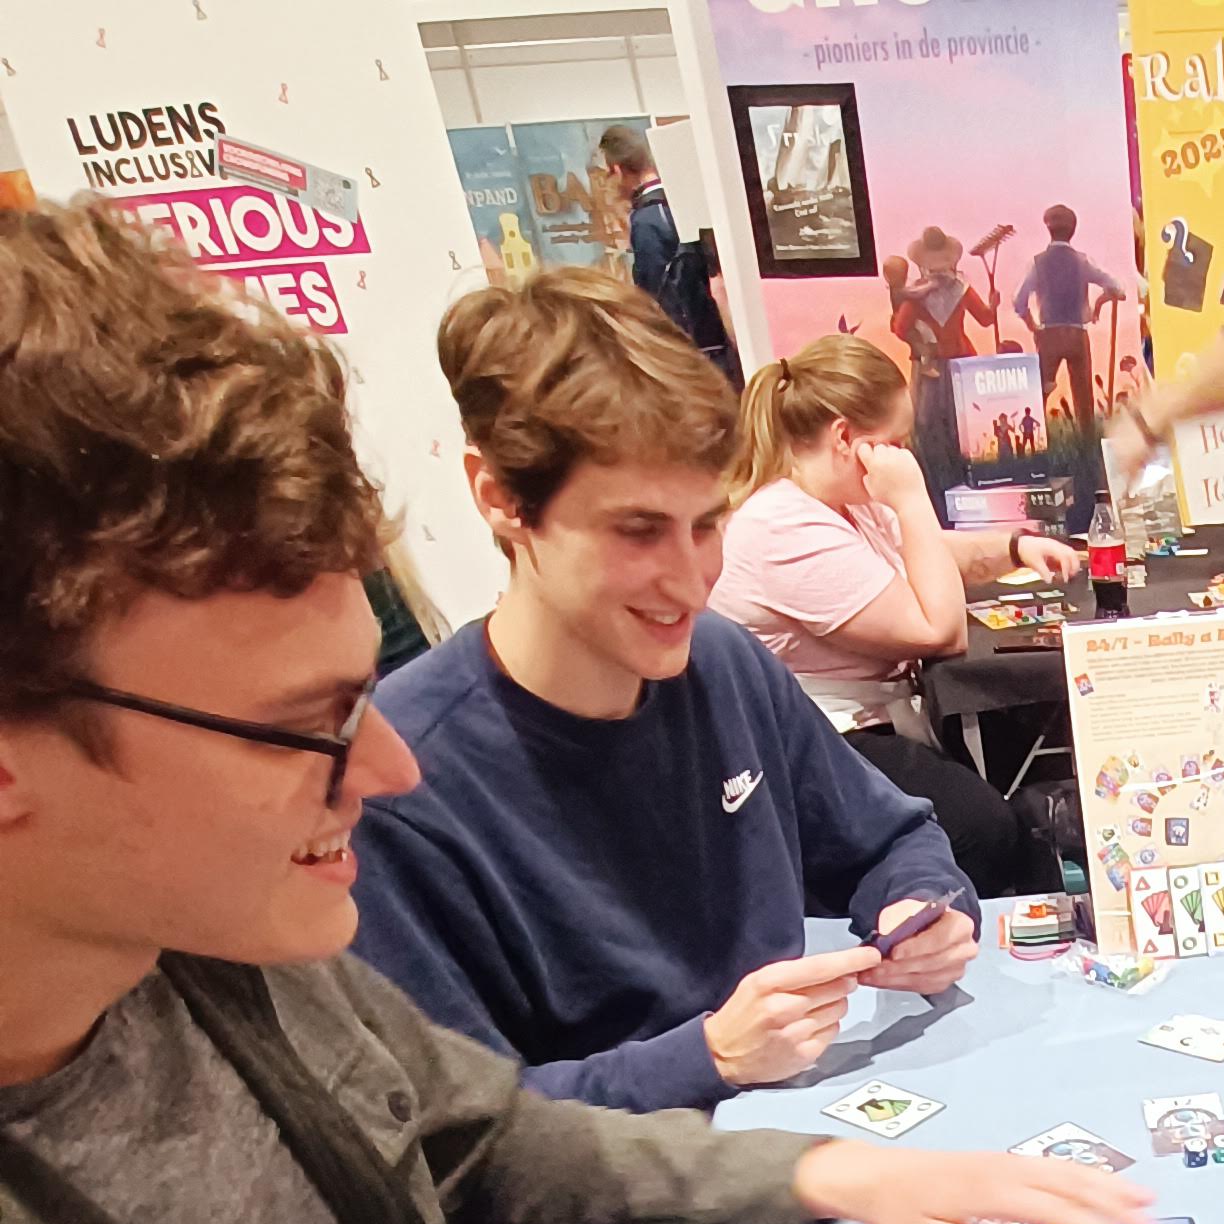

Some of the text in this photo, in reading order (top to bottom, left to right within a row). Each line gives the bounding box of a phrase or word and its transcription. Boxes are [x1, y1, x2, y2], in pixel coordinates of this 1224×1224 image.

[813, 37, 890, 70] pioniers
[895, 32, 913, 60] in
[919, 26, 941, 59] de
[947, 25, 1030, 64] provincie
[66, 102, 227, 156] LUDENS
[82, 147, 229, 188] INCLUSIV
[108, 194, 356, 258] ERIOUS
[974, 366, 1030, 397] GRUNN
[723, 769, 752, 800] NIKE
